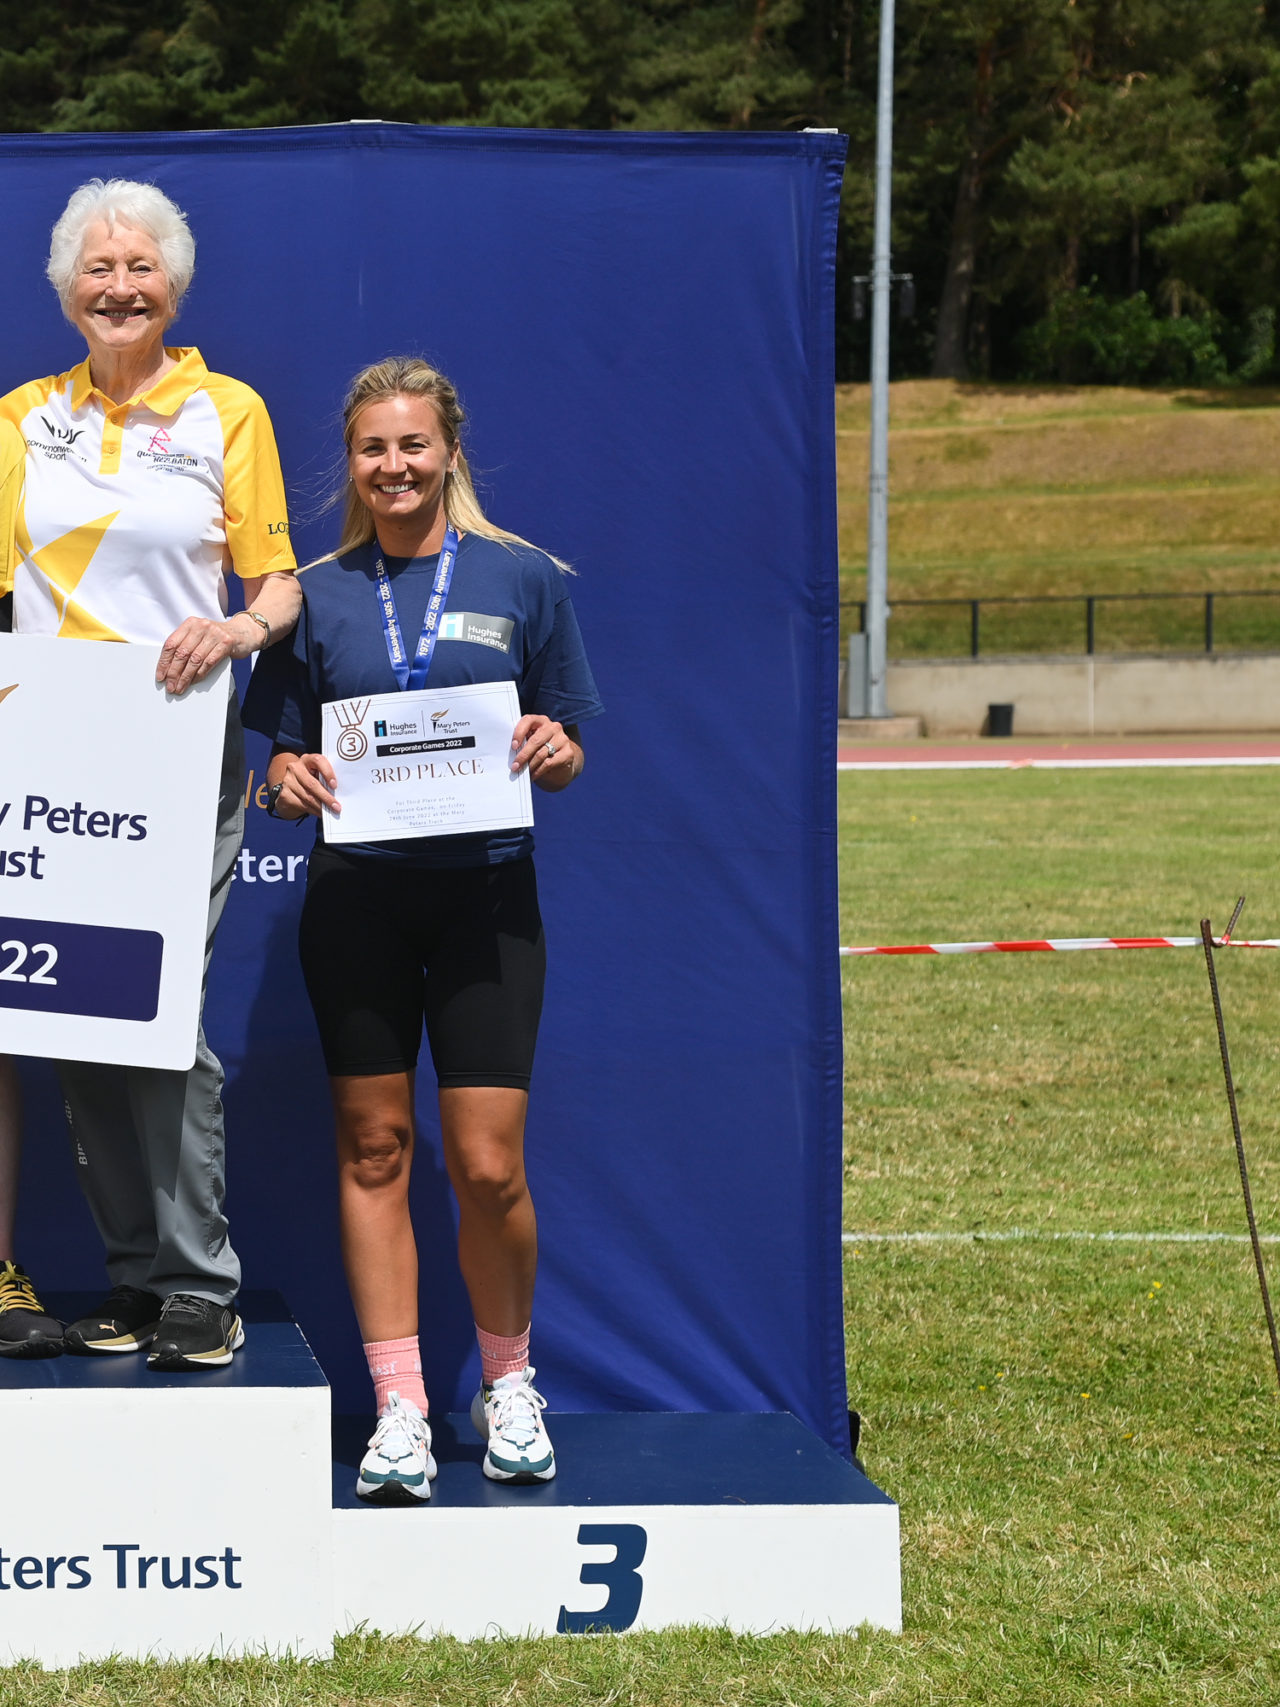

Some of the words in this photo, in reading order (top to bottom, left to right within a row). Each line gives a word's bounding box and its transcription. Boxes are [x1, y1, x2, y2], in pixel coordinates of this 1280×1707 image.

[376, 559, 385, 577] 1972
[435, 550, 453, 594] Anniversary
[380, 583, 391, 602] 2022
[384, 602, 394, 619] 50th
[431, 595, 442, 611] 50th
[426, 612, 438, 631] 2022
[388, 619, 403, 663] Anniversary
[467, 625, 503, 640] Hughes
[467, 633, 508, 651] Insurance
[419, 638, 431, 657] 1972
[390, 722, 417, 732] Hughes
[347, 738, 357, 752] 3
[390, 743, 422, 754] Corporate
[422, 742, 445, 750] Games
[371, 766, 411, 785] 3RD
[417, 759, 484, 780] PLACE
[23, 795, 148, 842] Peters
[231, 848, 310, 883] ter
[102, 1544, 242, 1589] Trust
[557, 1524, 648, 1634] 3
